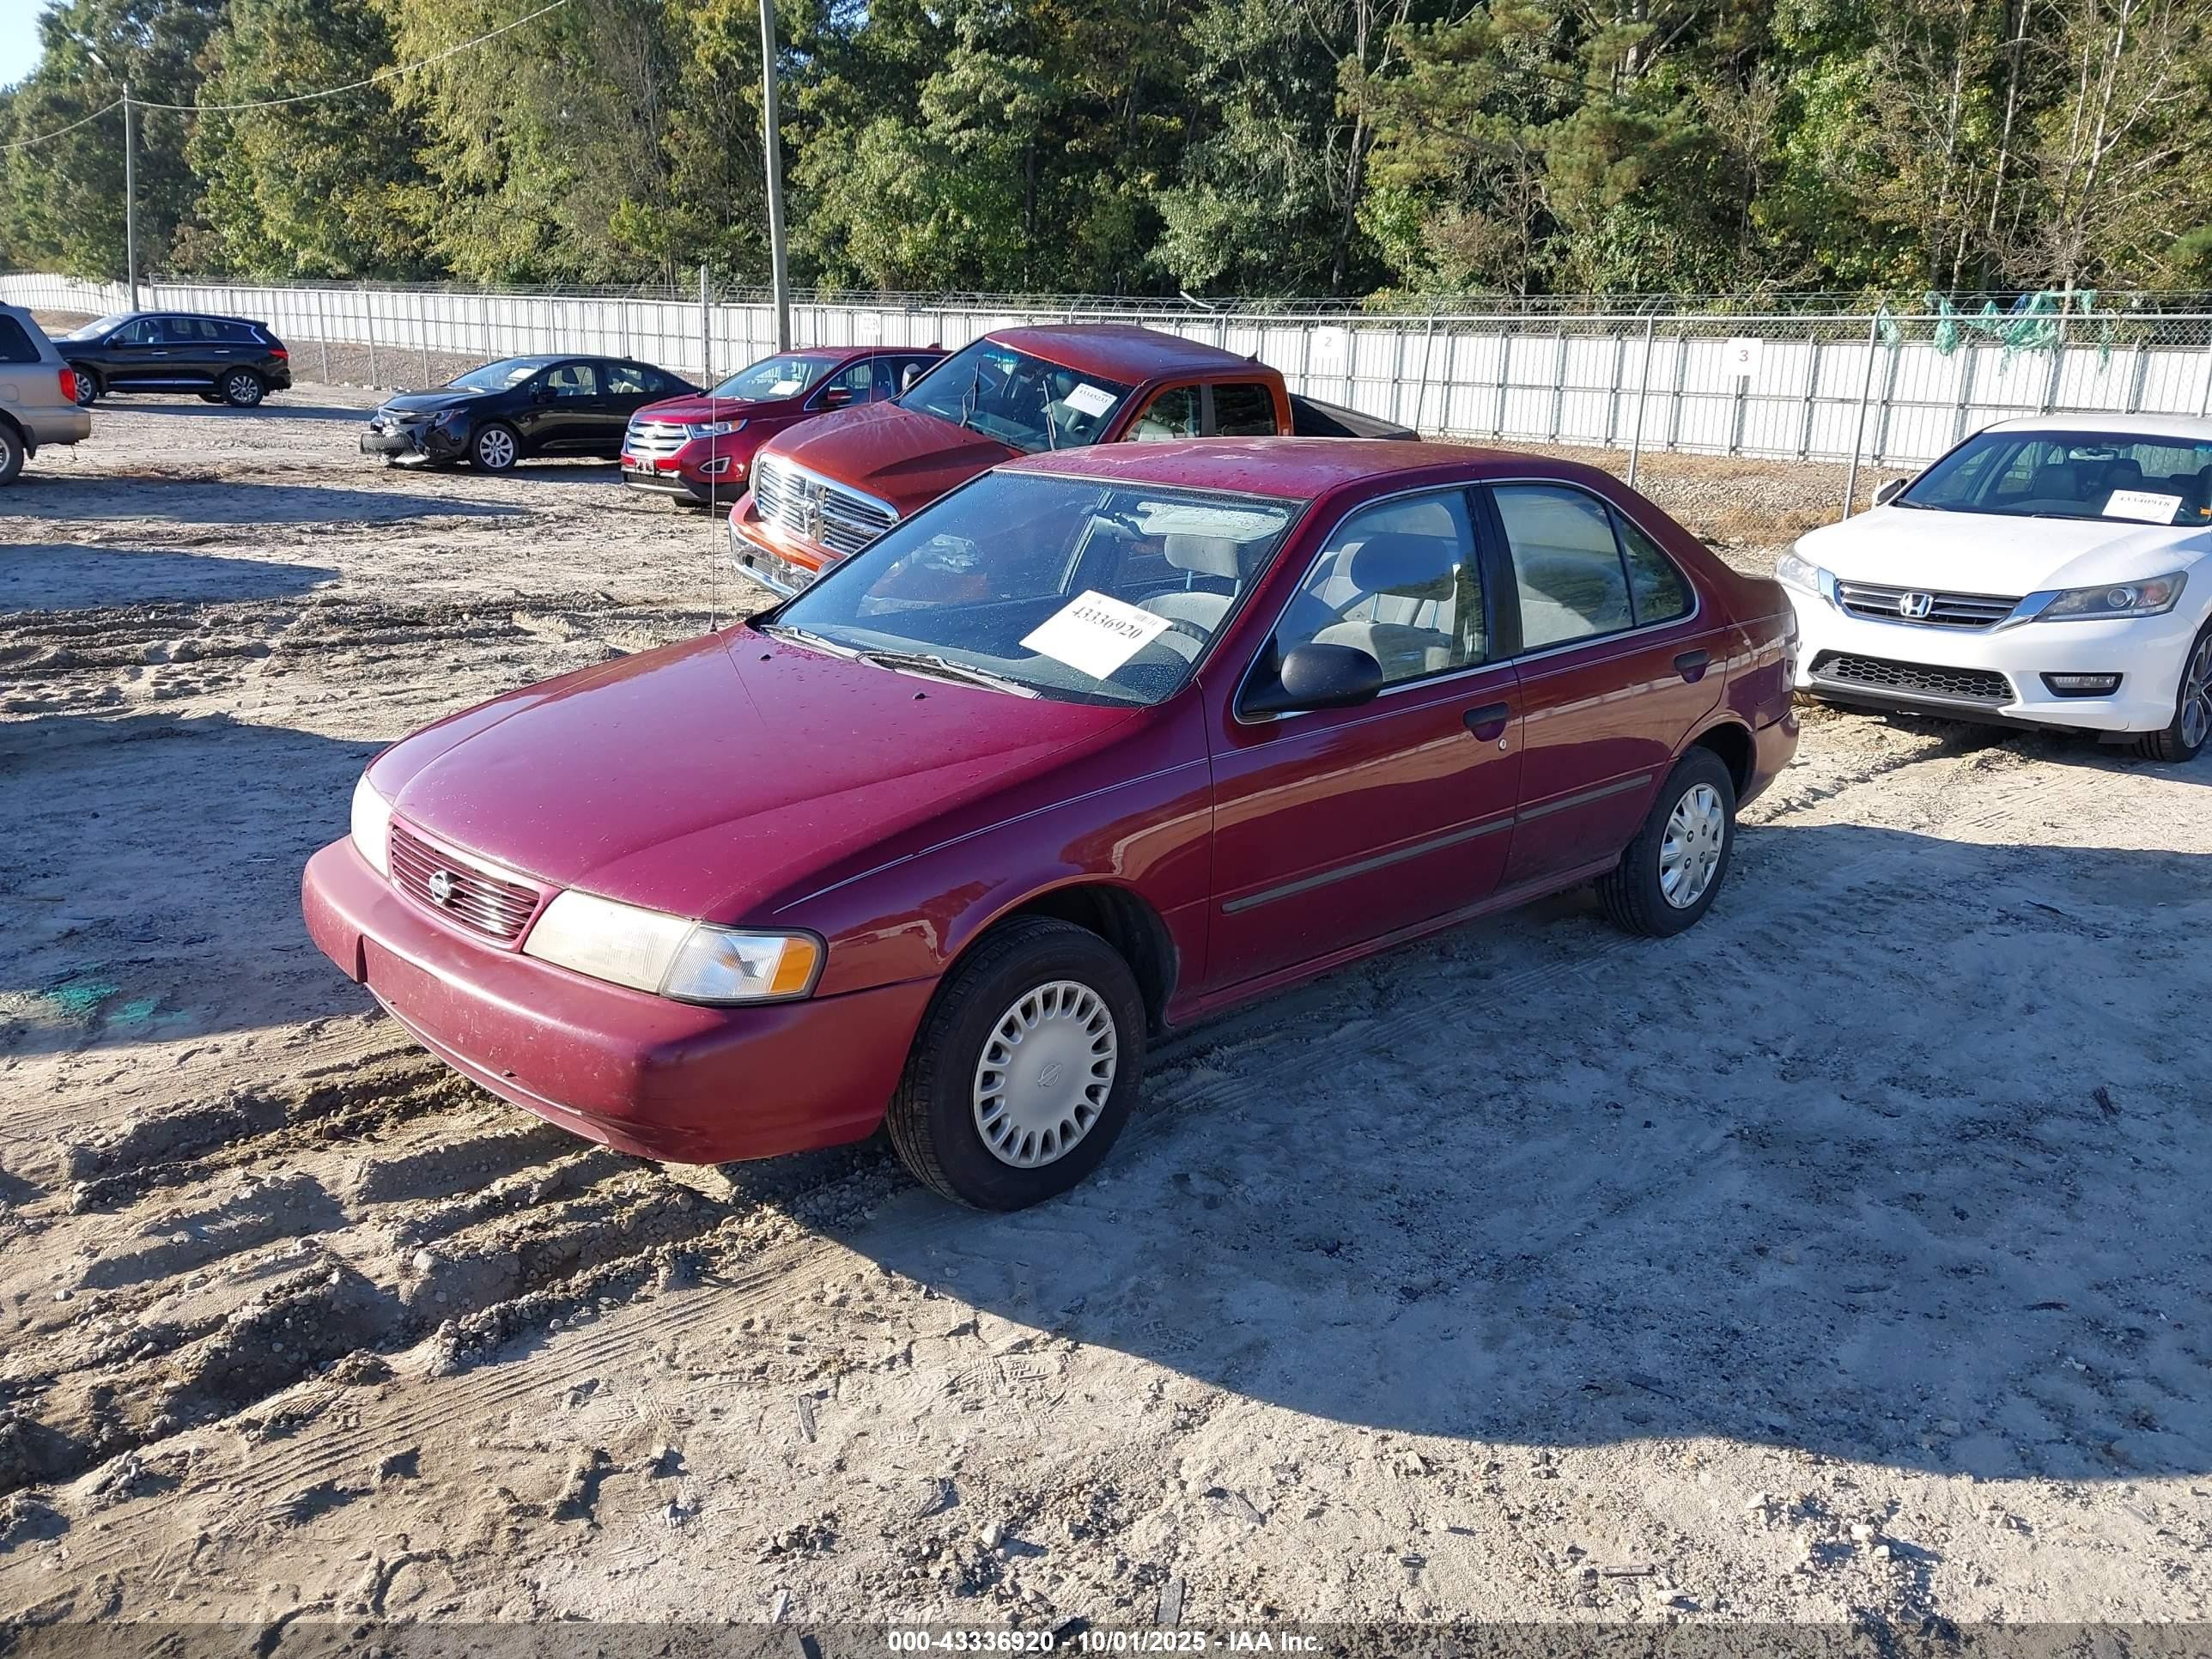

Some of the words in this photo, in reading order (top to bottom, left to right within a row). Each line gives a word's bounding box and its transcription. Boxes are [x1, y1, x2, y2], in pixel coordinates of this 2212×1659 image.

[1324, 336, 1332, 347] 2
[1739, 349, 1749, 362] 3
[1073, 605, 1143, 640] 43336920
